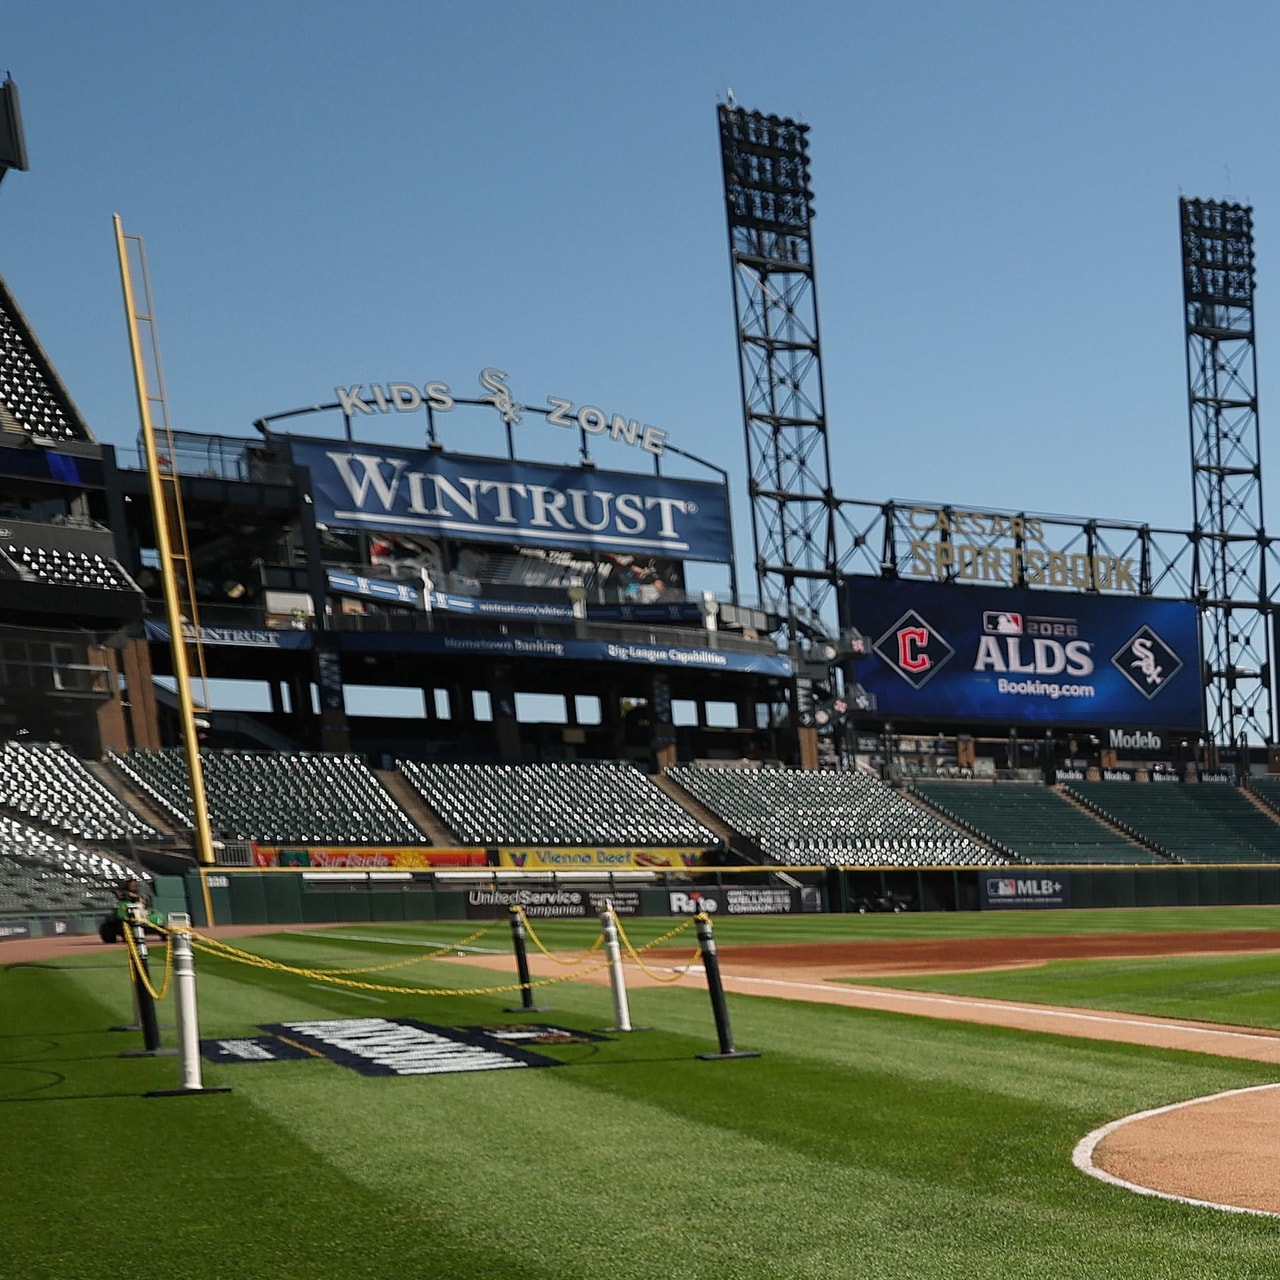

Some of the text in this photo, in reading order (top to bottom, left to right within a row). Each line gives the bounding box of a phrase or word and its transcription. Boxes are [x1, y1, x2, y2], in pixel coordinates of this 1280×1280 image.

[335, 382, 456, 418] KIDS
[546, 395, 669, 456] ZONE
[326, 451, 686, 539] WINTRUST
[908, 506, 1046, 543] CAESARS
[909, 539, 1136, 592] SPORTSBOOK
[1026, 621, 1078, 637] 2026
[973, 636, 1094, 677] ALDS
[998, 678, 1095, 699] Booking.com
[1108, 728, 1162, 749] Modelo
[1103, 770, 1131, 781] Modelo
[536, 850, 592, 864] Vienna
[596, 850, 632, 864] Beef
[1017, 879, 1062, 895] MLB+
[669, 891, 718, 913] Rate
